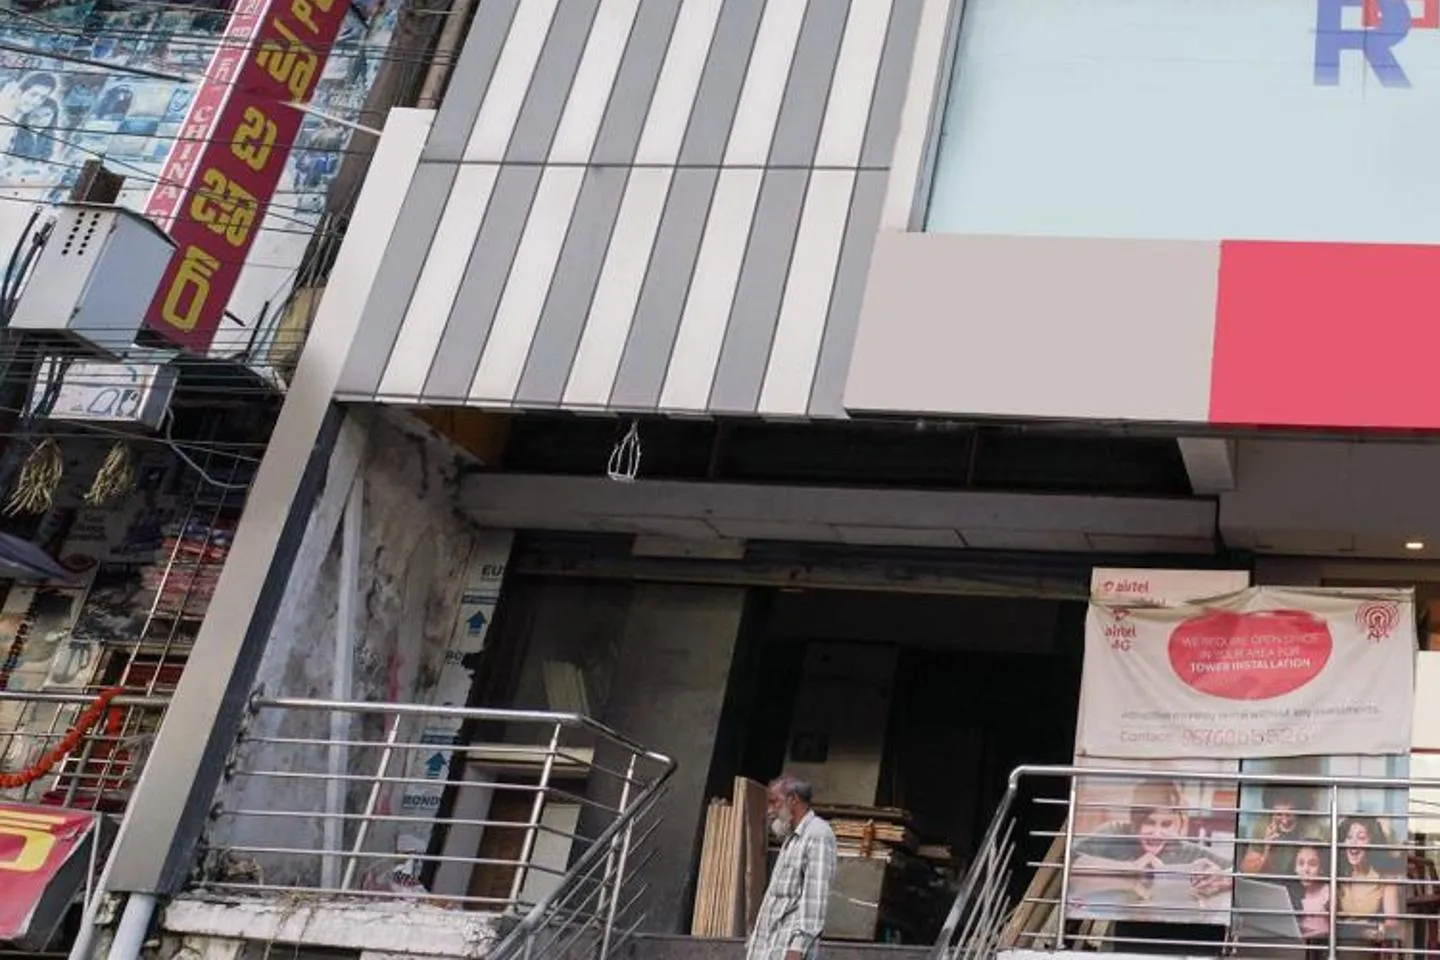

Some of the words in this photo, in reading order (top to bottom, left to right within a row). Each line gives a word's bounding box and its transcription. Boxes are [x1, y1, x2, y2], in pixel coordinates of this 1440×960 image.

[157, 106, 213, 200] CHINA
[1115, 580, 1150, 593] airtel
[1105, 624, 1137, 638] airtel
[1111, 639, 1132, 652] 4G
[1191, 660, 1231, 673] TOWER
[1232, 656, 1311, 671] INSTALLATION
